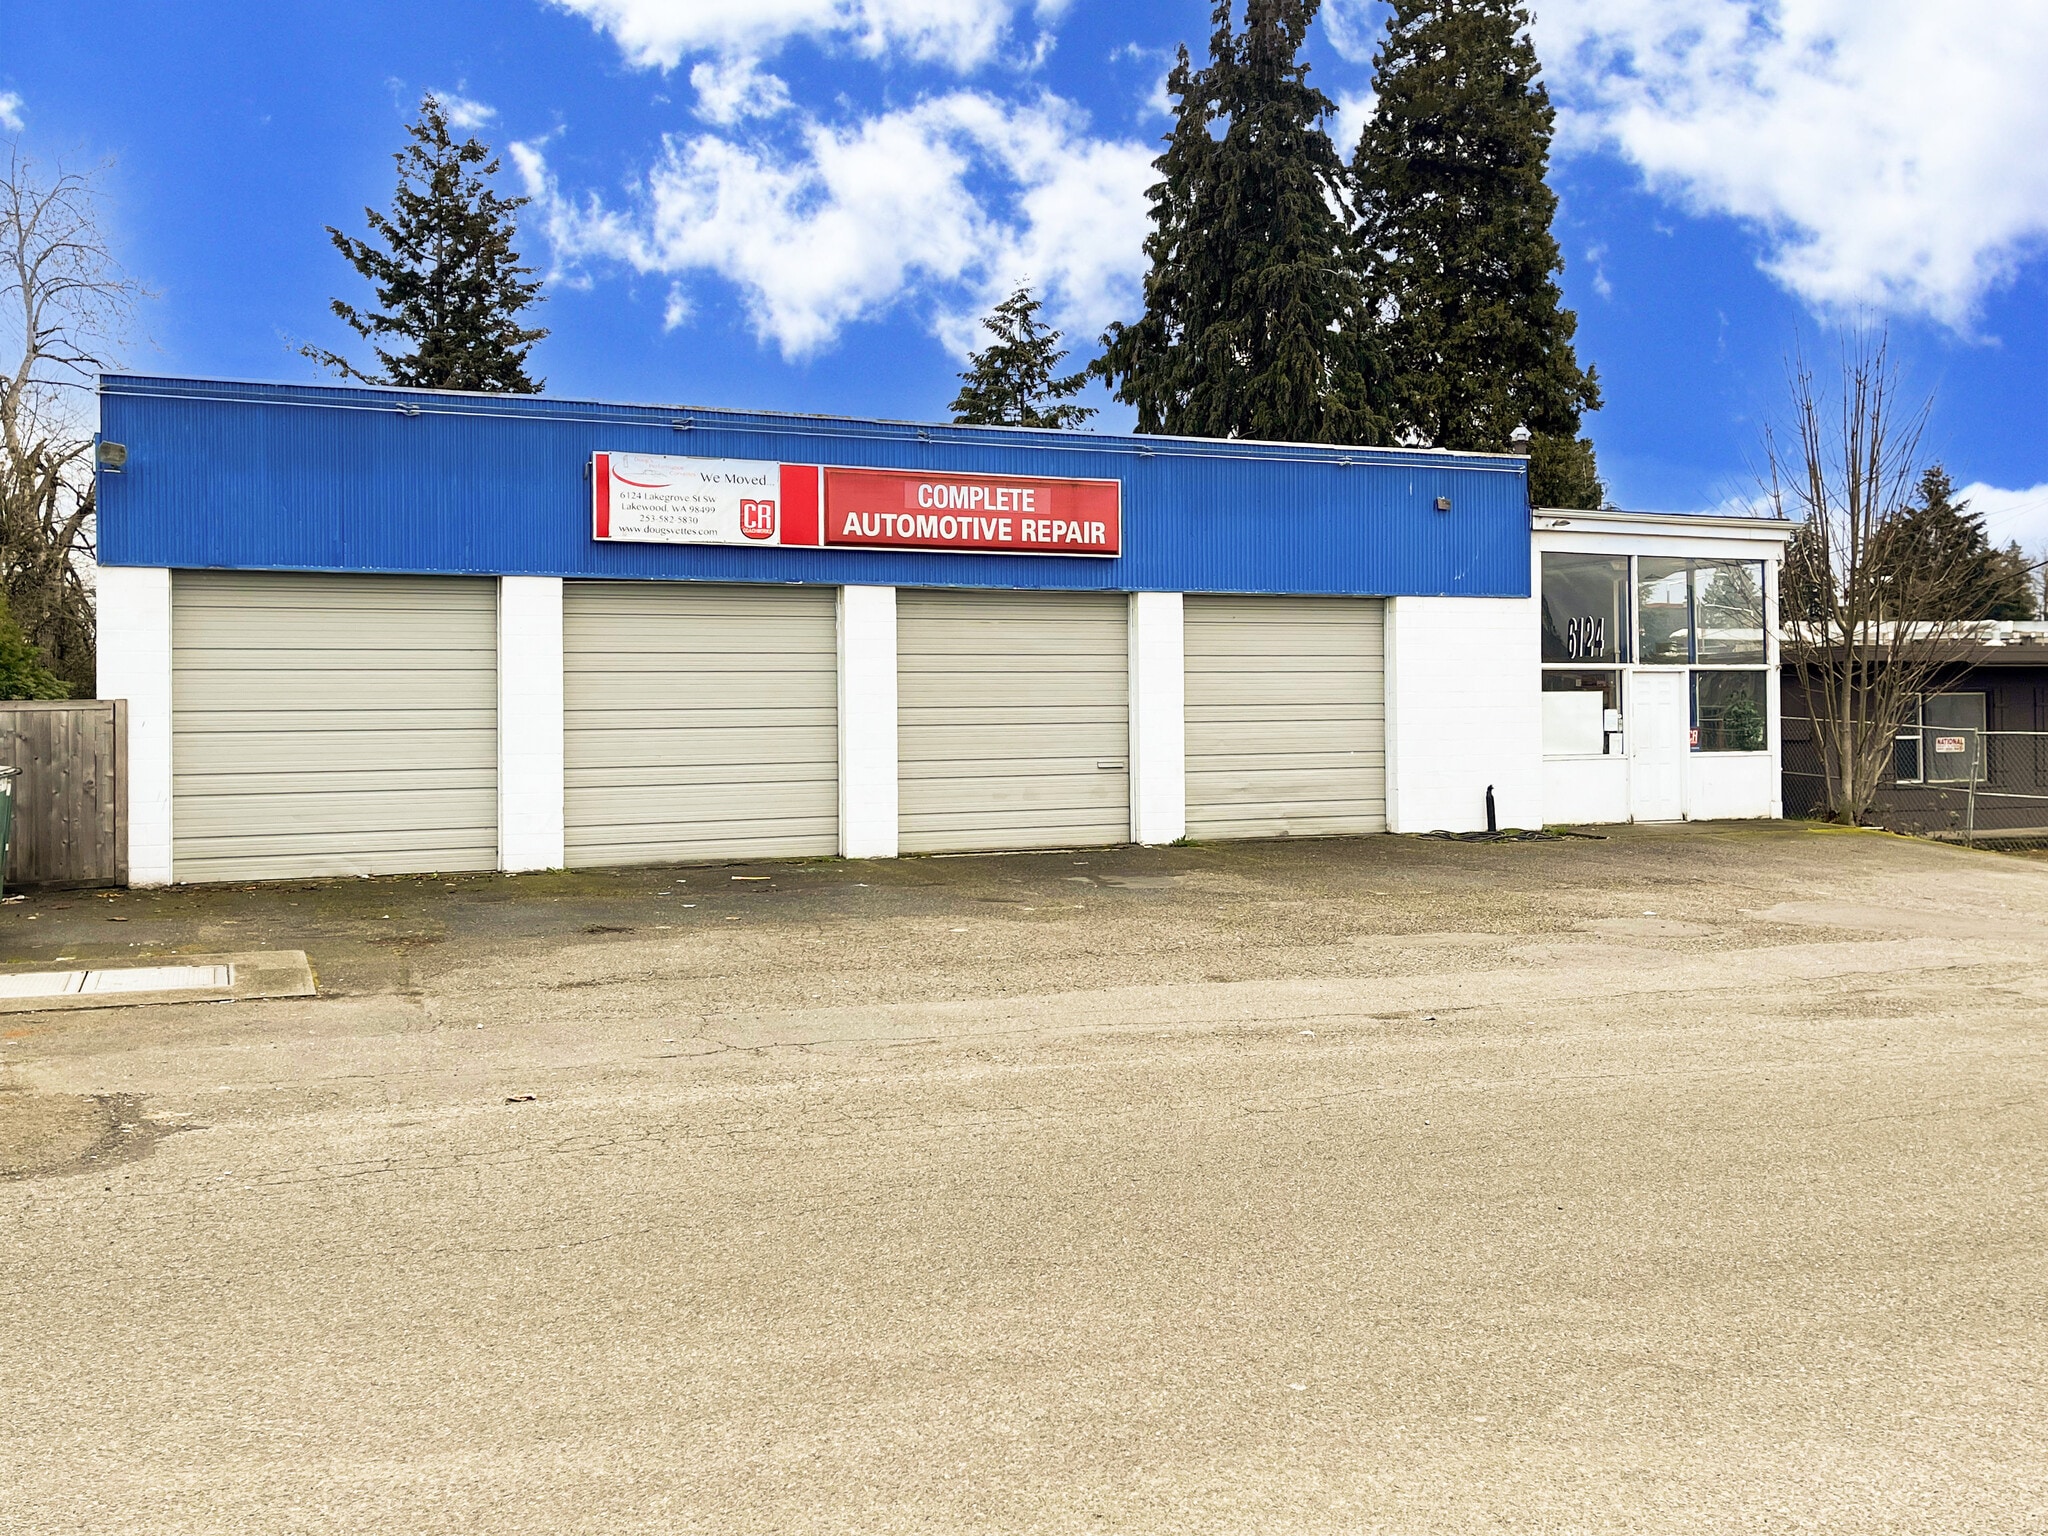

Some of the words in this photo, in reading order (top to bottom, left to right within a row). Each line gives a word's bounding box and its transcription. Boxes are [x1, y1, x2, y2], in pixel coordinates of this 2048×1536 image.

[700, 472, 720, 484] We
[620, 492, 642, 500] 6124
[644, 493, 690, 503] Lakegrove
[692, 495, 701, 503] St
[917, 484, 1035, 511] COMPLETE
[640, 514, 699, 524] 253-582-5830
[689, 506, 716, 514] 98499
[743, 503, 772, 529] CR
[842, 512, 1012, 541] AUTOMOTIVE
[1021, 519, 1106, 545] REPAIR
[1567, 614, 1605, 659] 6124
